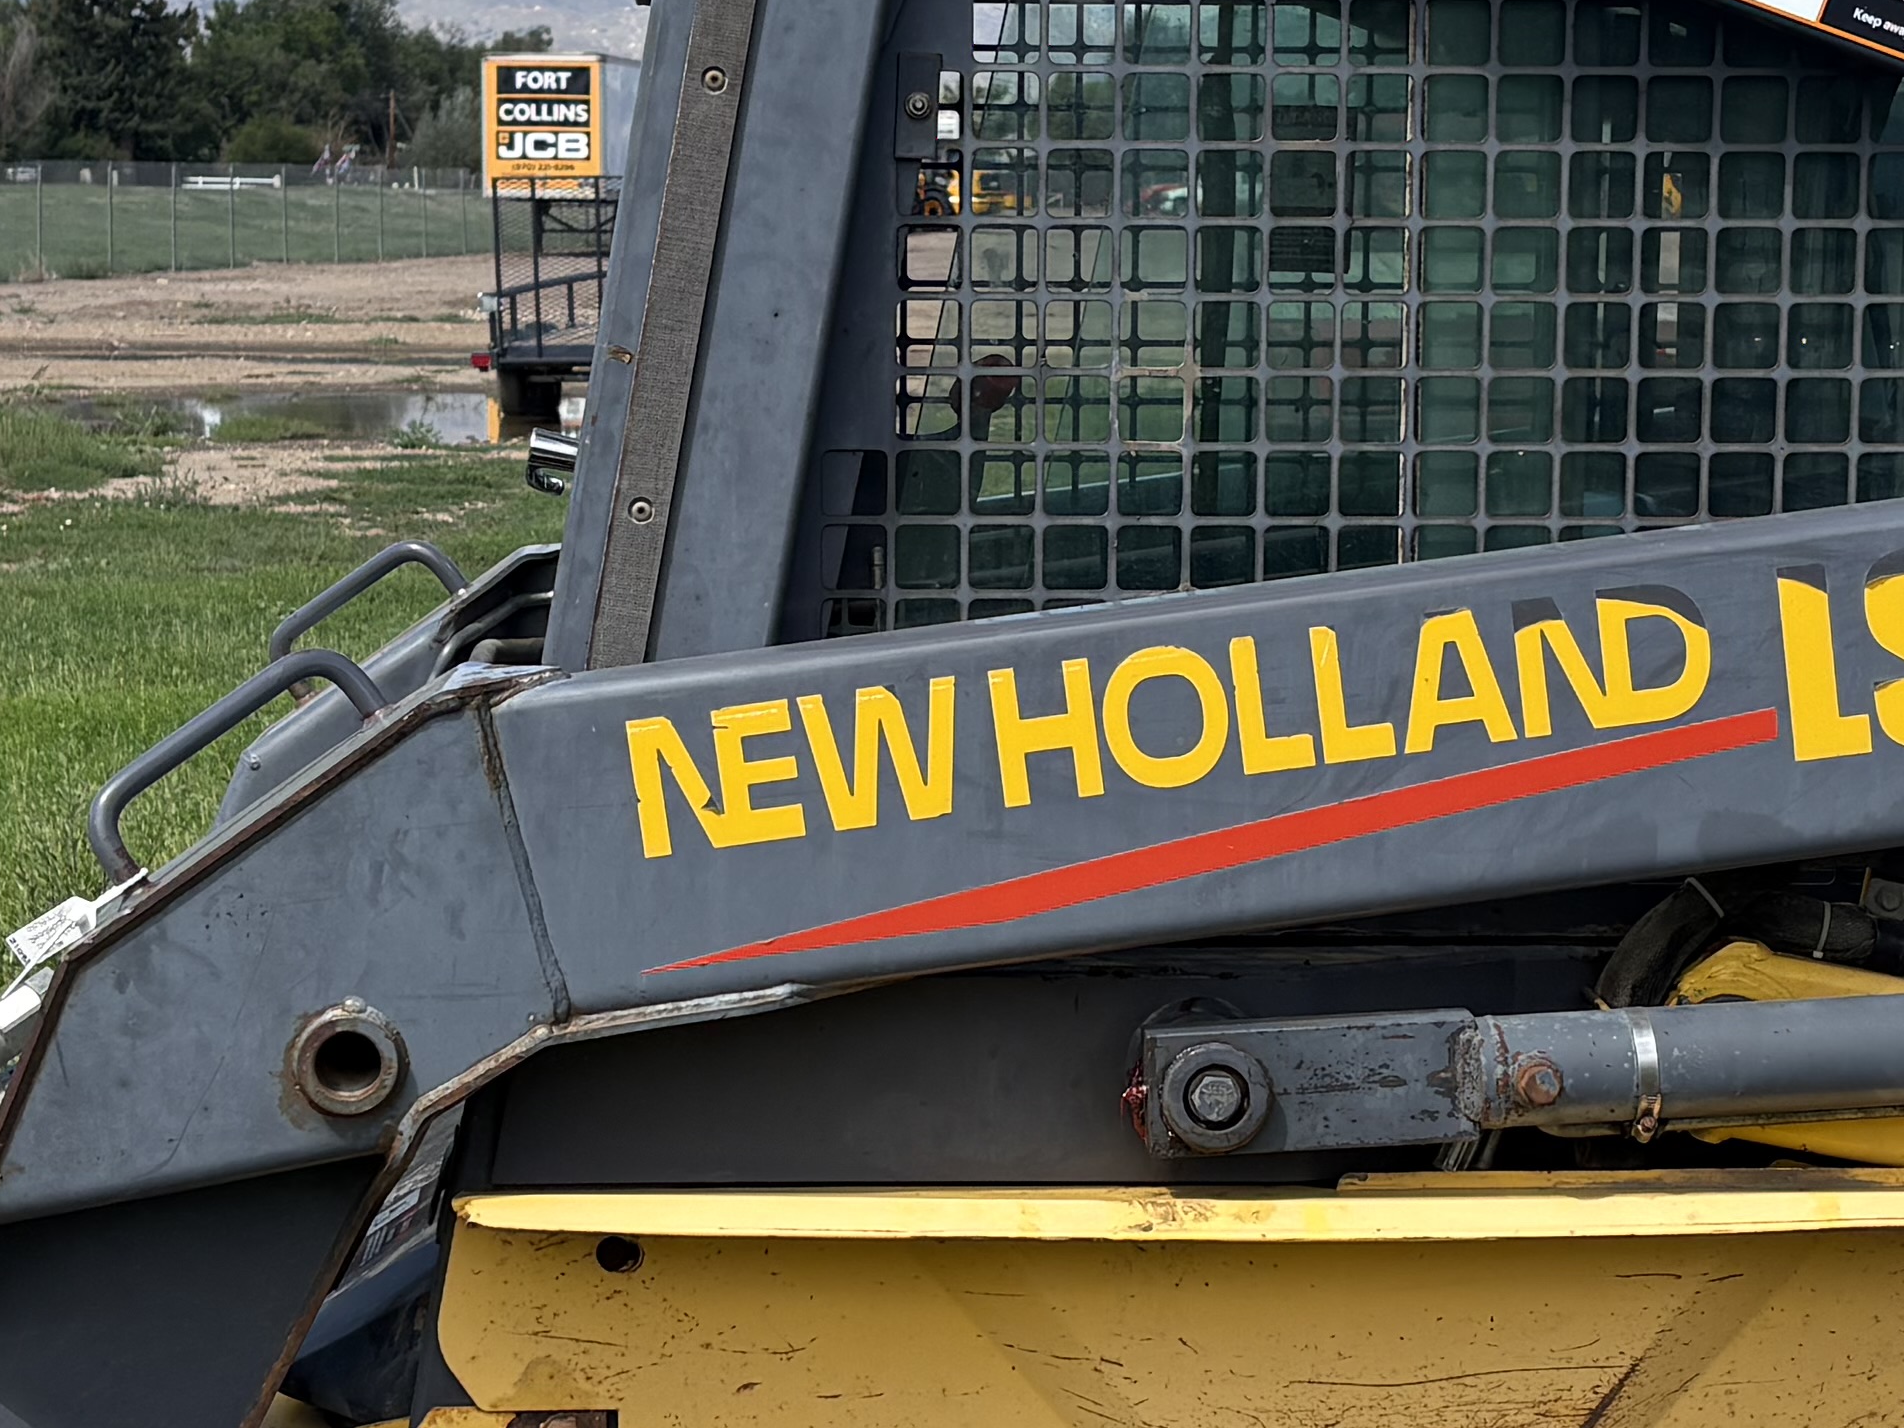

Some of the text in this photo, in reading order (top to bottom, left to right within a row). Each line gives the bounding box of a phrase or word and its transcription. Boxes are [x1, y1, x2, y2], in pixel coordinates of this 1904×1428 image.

[1853, 7, 1882, 29] Keep
[514, 71, 572, 90] FORT
[499, 103, 589, 123] COLLINS
[498, 132, 589, 159] JCB
[625, 675, 955, 859] NEW
[987, 590, 1711, 809] HOLLAND
